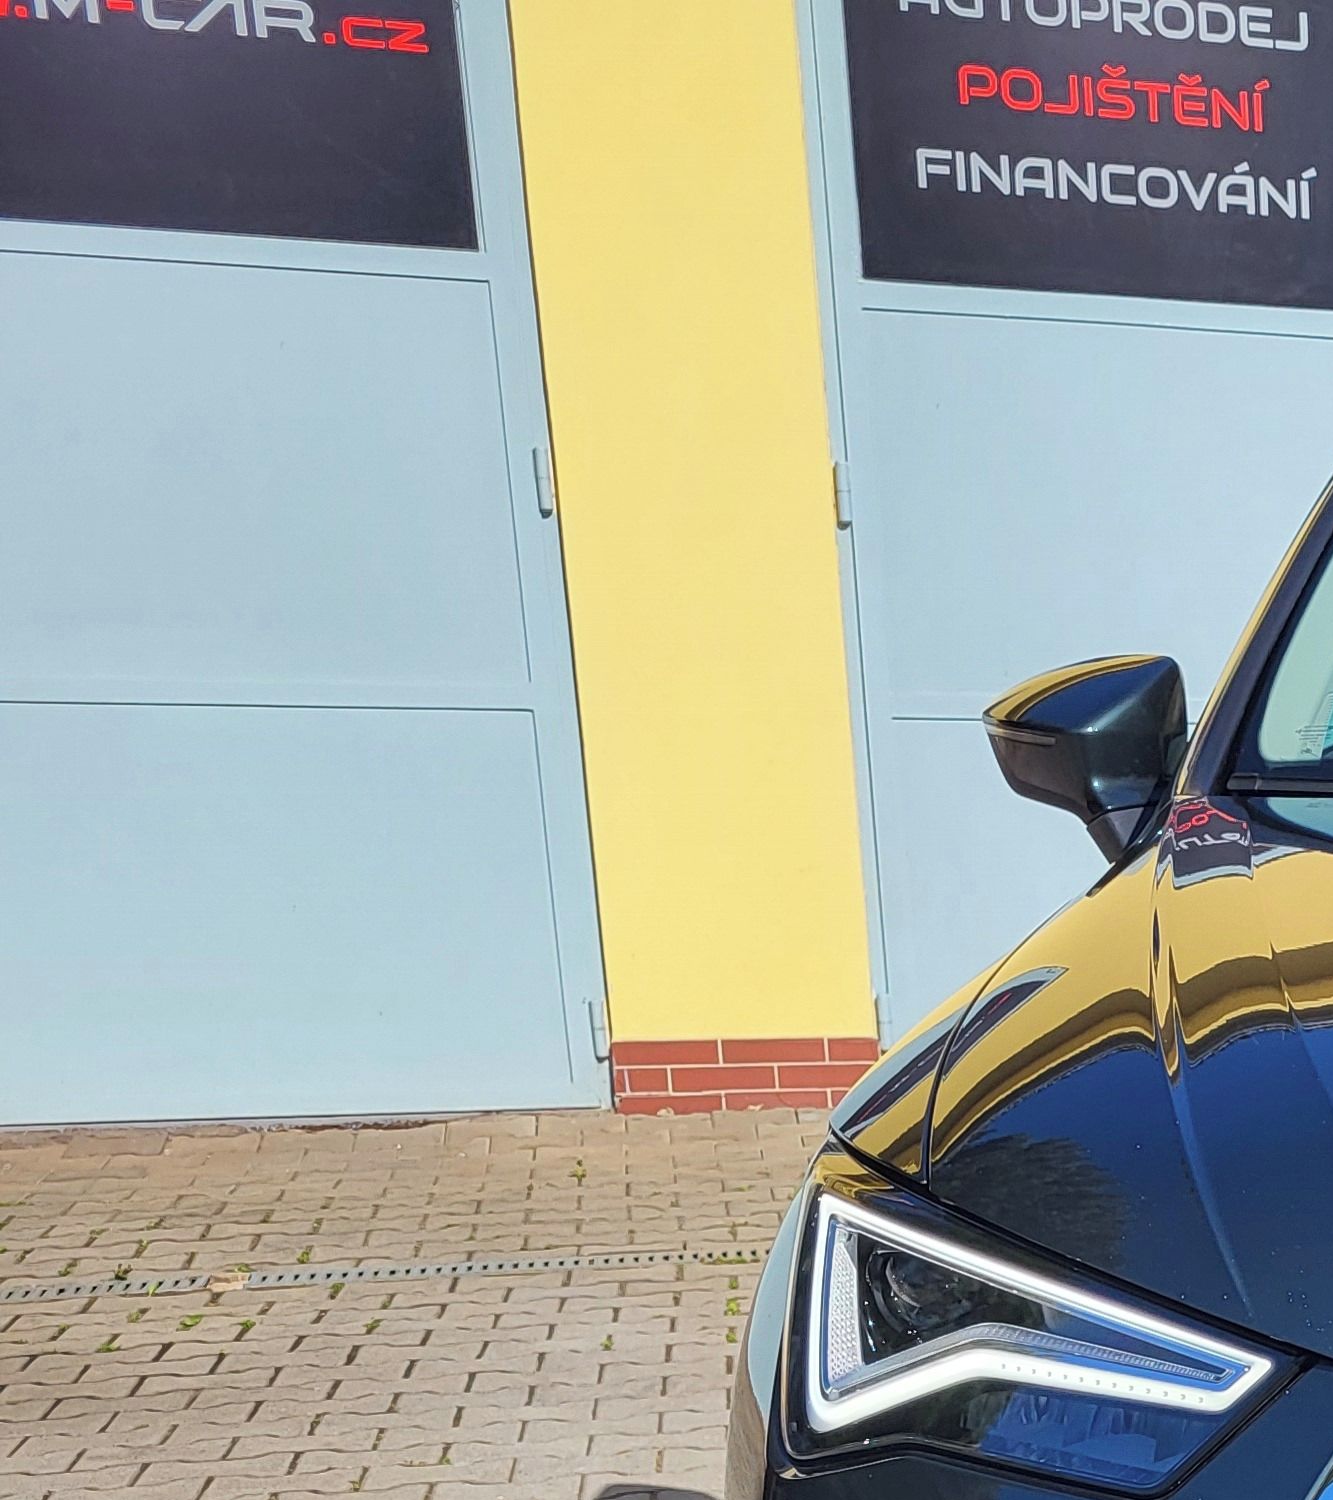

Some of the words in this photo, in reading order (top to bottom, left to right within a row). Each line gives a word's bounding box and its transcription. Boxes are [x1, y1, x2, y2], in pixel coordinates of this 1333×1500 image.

[0, 0, 430, 54] .M-CAR.cz
[957, 64, 1270, 132] POJIŠTĚNÍ
[915, 148, 1318, 220] FINANCOVÁNÍ
